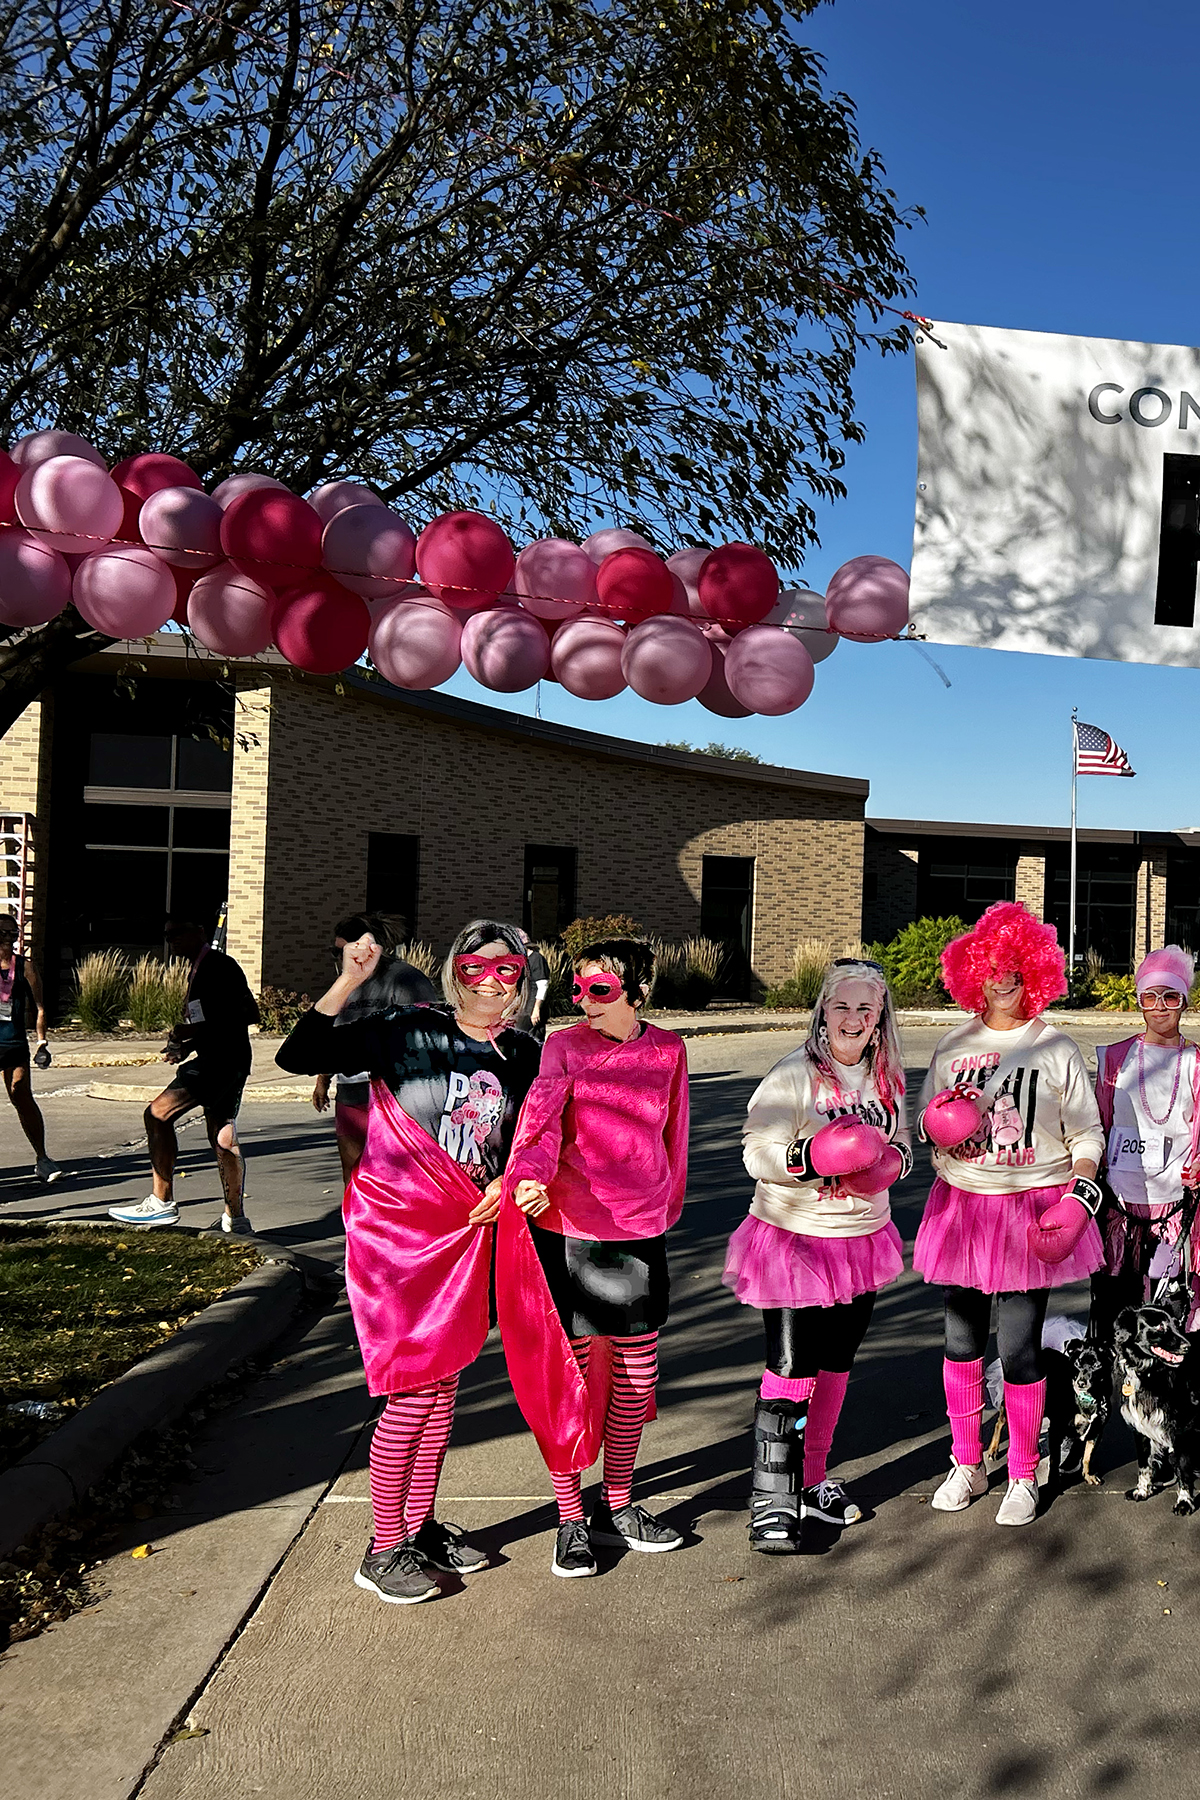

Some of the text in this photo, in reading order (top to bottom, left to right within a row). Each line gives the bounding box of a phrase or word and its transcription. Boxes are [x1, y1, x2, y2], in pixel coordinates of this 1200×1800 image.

[950, 1052, 1001, 1073] CANCER
[1121, 1138, 1146, 1155] 205
[996, 1147, 1036, 1167] CLUB
